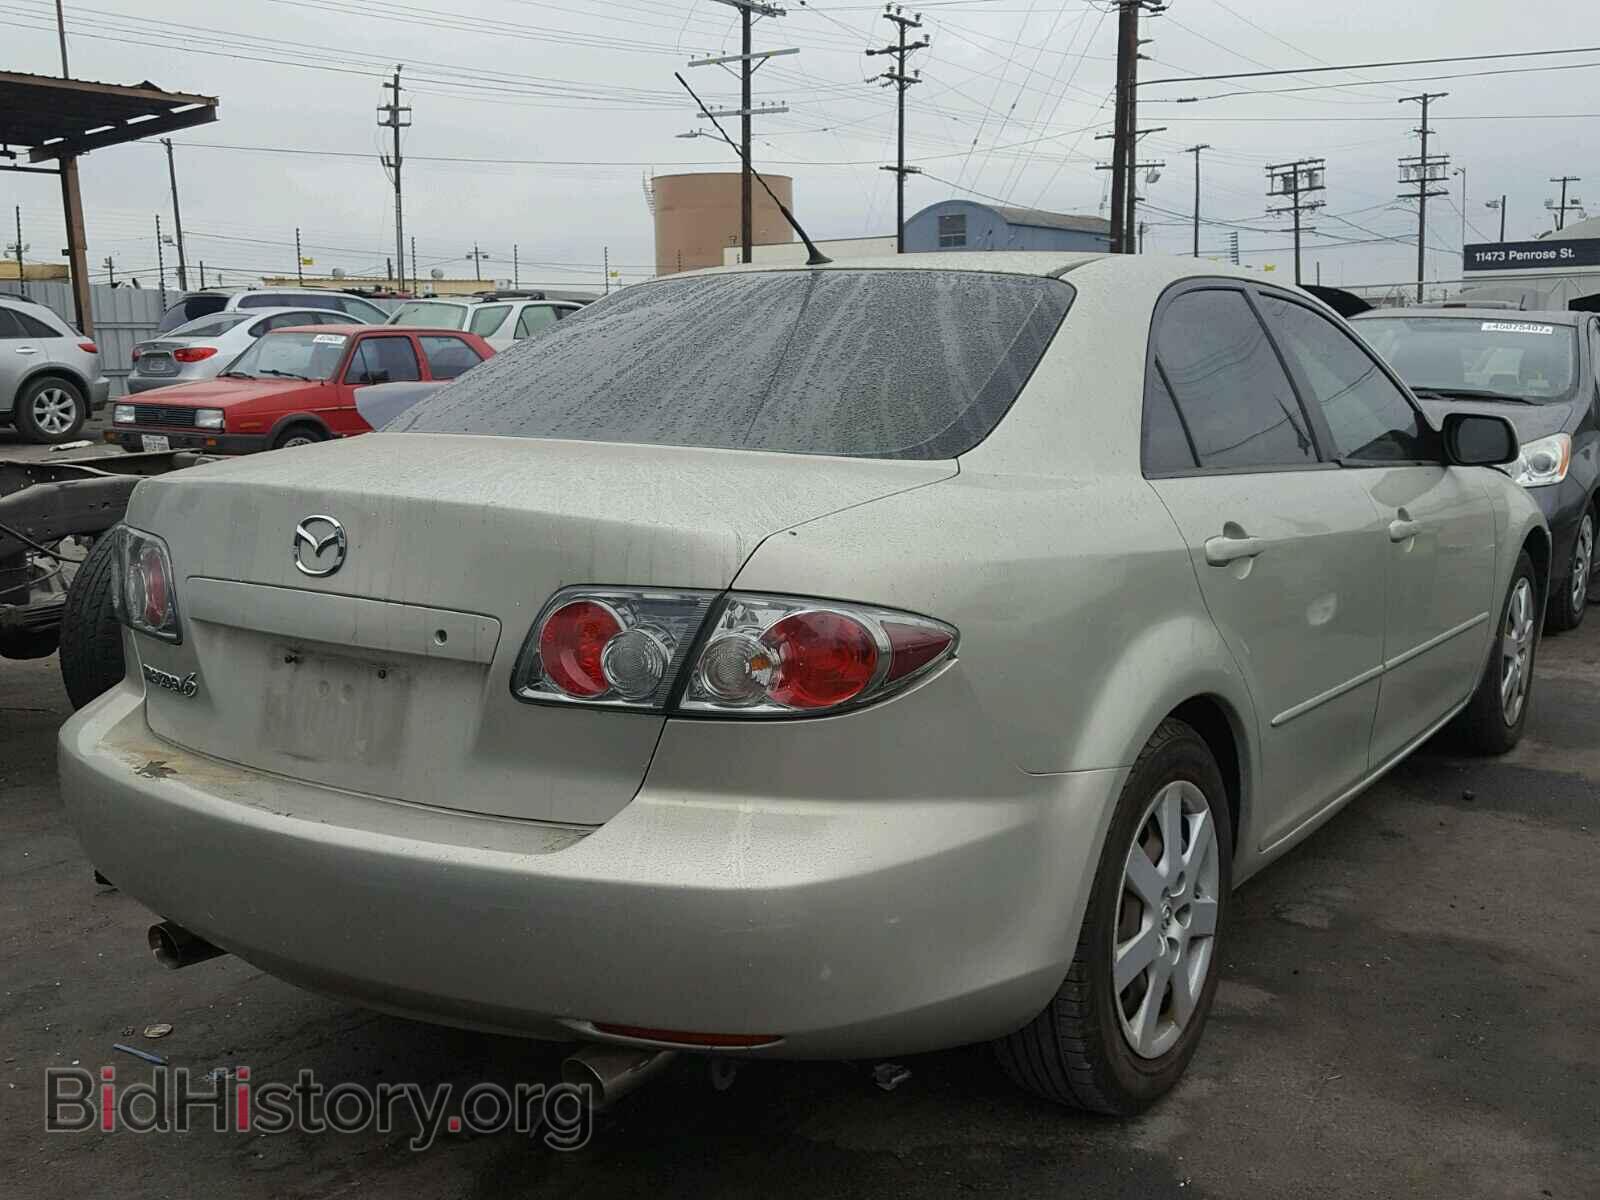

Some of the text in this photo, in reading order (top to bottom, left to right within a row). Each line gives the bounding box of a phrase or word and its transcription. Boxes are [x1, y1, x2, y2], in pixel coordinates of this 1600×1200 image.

[1475, 247, 1576, 262] 11473 Penrose St.
